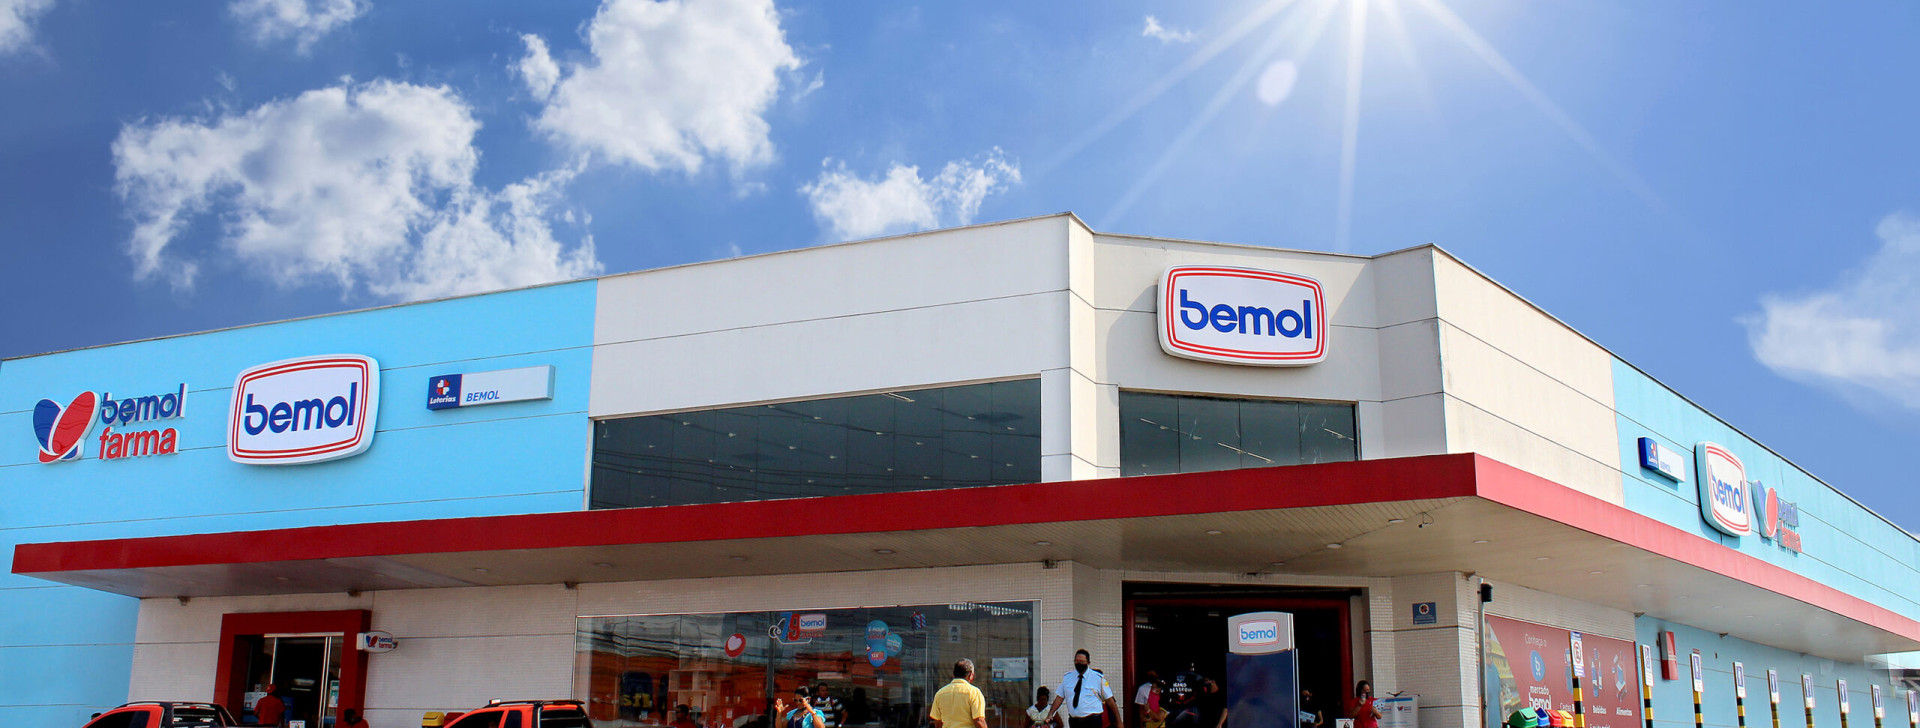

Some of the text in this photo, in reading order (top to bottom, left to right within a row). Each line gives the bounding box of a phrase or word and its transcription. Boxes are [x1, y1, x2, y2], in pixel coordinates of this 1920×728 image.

[1180, 289, 1312, 339] bemol
[429, 395, 456, 405] Loterias
[466, 390, 500, 402] BEMOL
[101, 383, 186, 425] bemol
[244, 382, 357, 435] bemol
[99, 426, 177, 460] farma
[1710, 464, 1745, 514] bemol
[800, 618, 825, 627] bemol
[1240, 626, 1276, 640] bemol
[1525, 633, 1543, 647] Conheça
[1529, 685, 1549, 695] mercado
